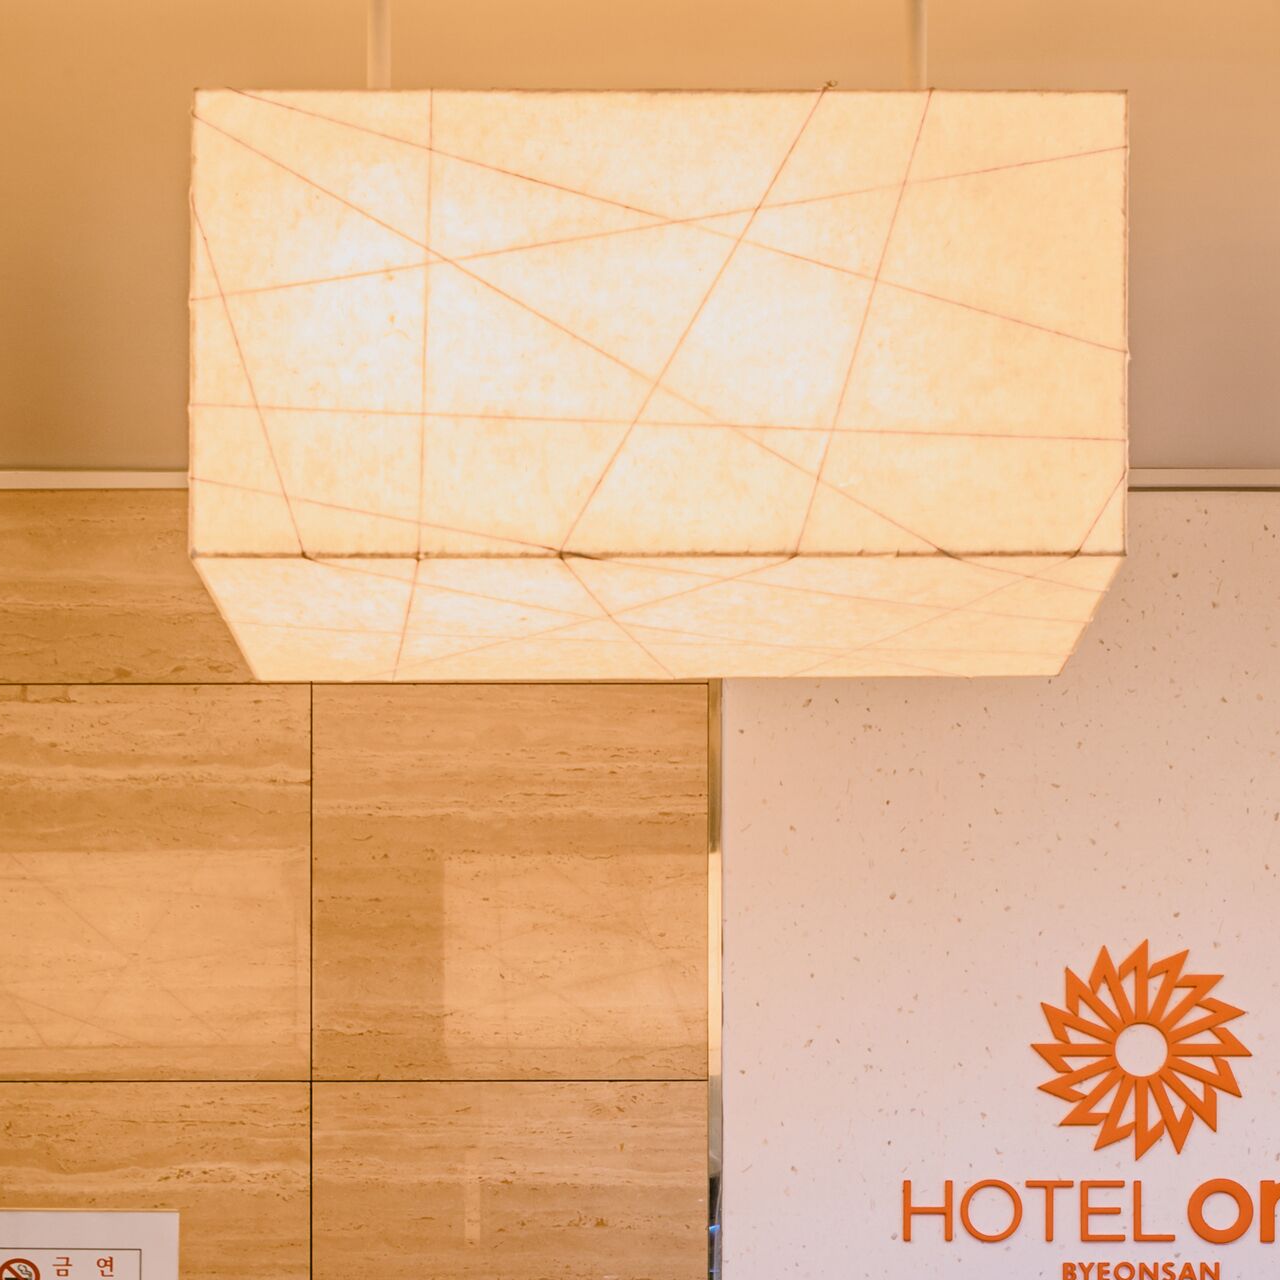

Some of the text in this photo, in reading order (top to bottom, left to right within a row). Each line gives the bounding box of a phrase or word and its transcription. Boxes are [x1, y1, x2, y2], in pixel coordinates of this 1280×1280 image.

[902, 1179, 1176, 1243] HOTEL
[52, 1256, 114, 1277] 금 연
